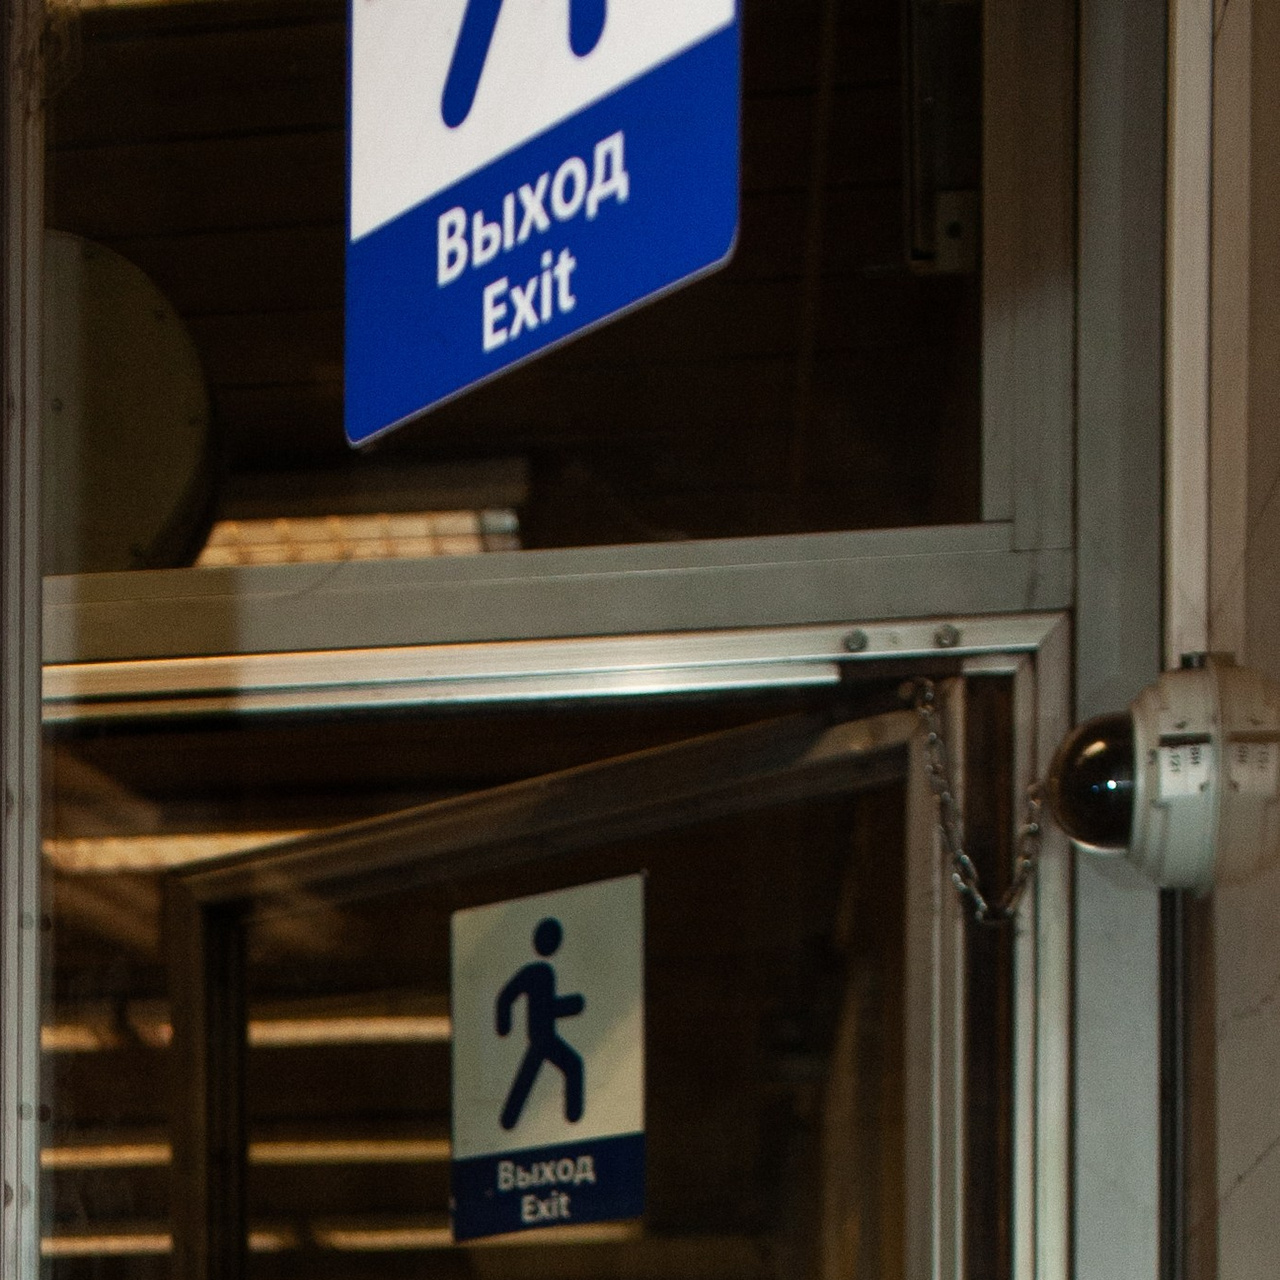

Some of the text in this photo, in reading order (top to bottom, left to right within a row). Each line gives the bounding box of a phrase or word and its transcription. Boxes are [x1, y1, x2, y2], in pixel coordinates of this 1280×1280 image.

[436, 130, 630, 289] Выход
[483, 248, 576, 353] Exit
[498, 1155, 595, 1191] Выход
[522, 1190, 570, 1223] Exit
